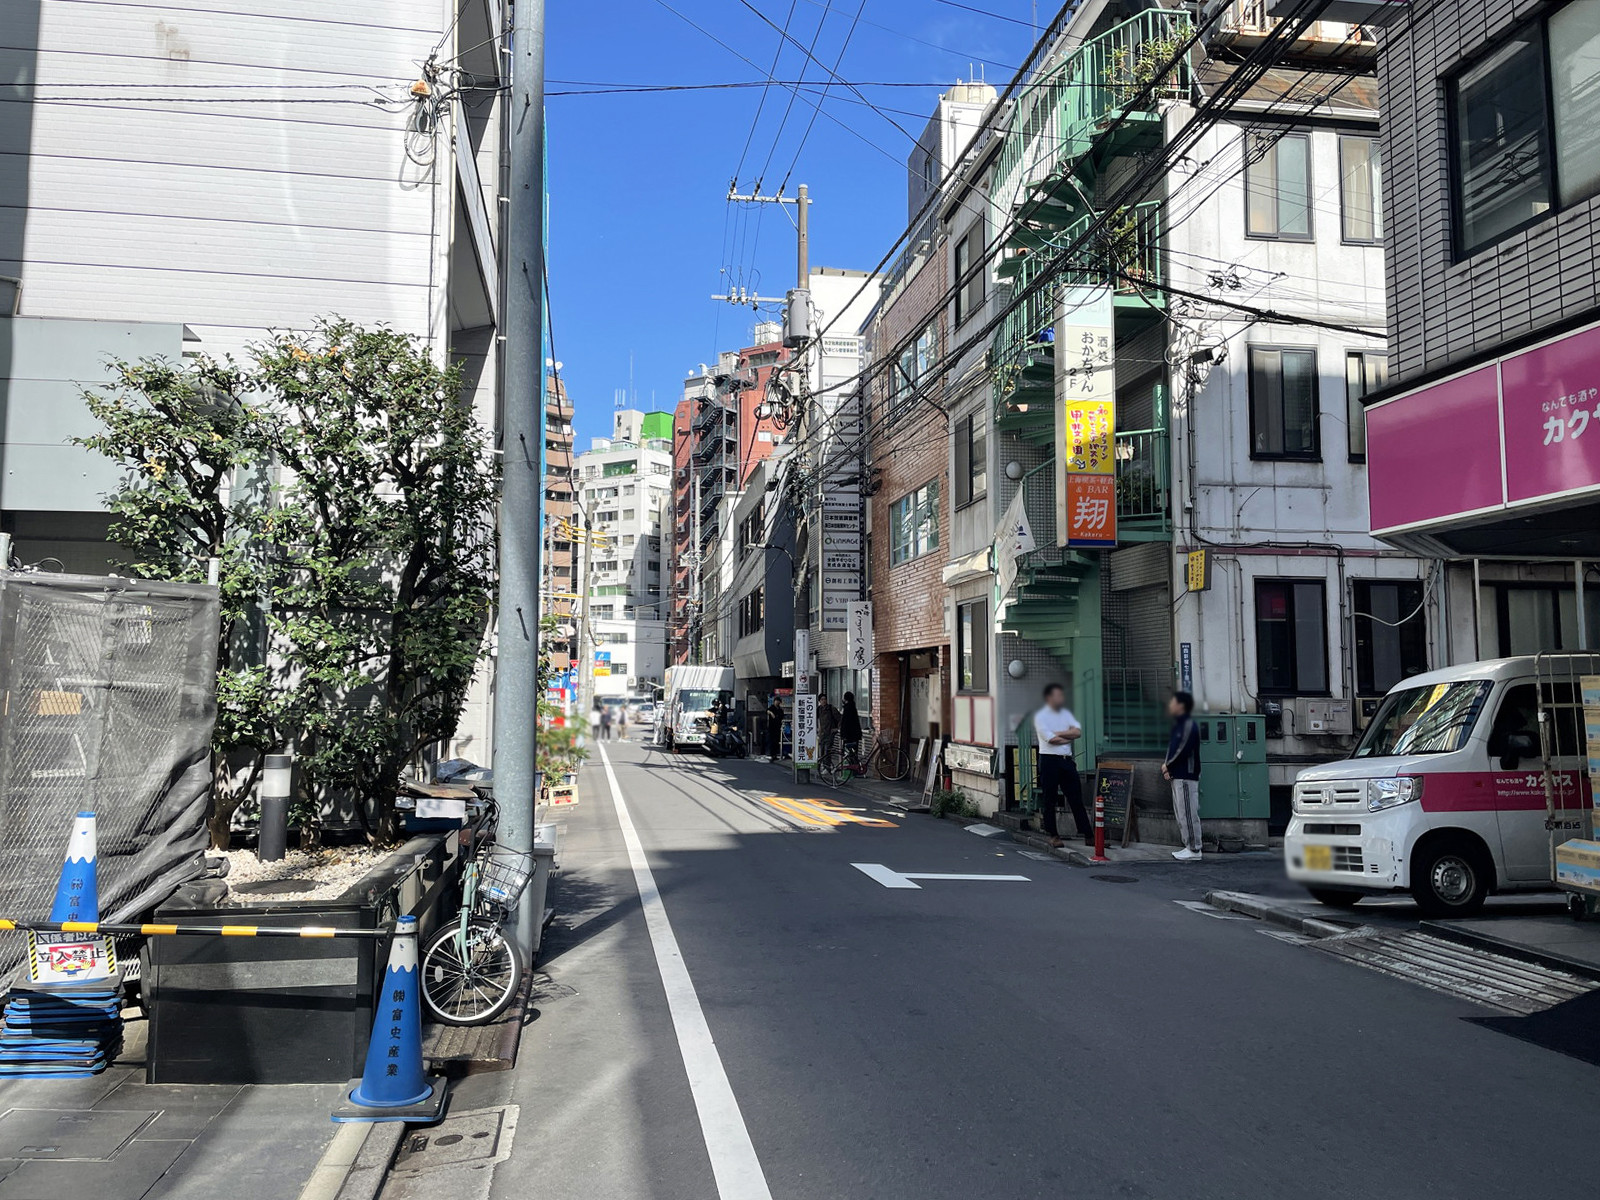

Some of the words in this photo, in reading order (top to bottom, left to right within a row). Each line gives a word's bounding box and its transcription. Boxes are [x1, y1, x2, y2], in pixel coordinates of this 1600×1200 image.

[1097, 336, 1108, 362] 酒処
[1081, 332, 1094, 392] おかちゃん
[1069, 368, 1077, 388] 2F
[1542, 388, 1598, 413] なんでも酒や
[1073, 496, 1109, 529] 翔
[1526, 774, 1574, 787] カクヤス
[38, 948, 106, 963] 立入禁止
